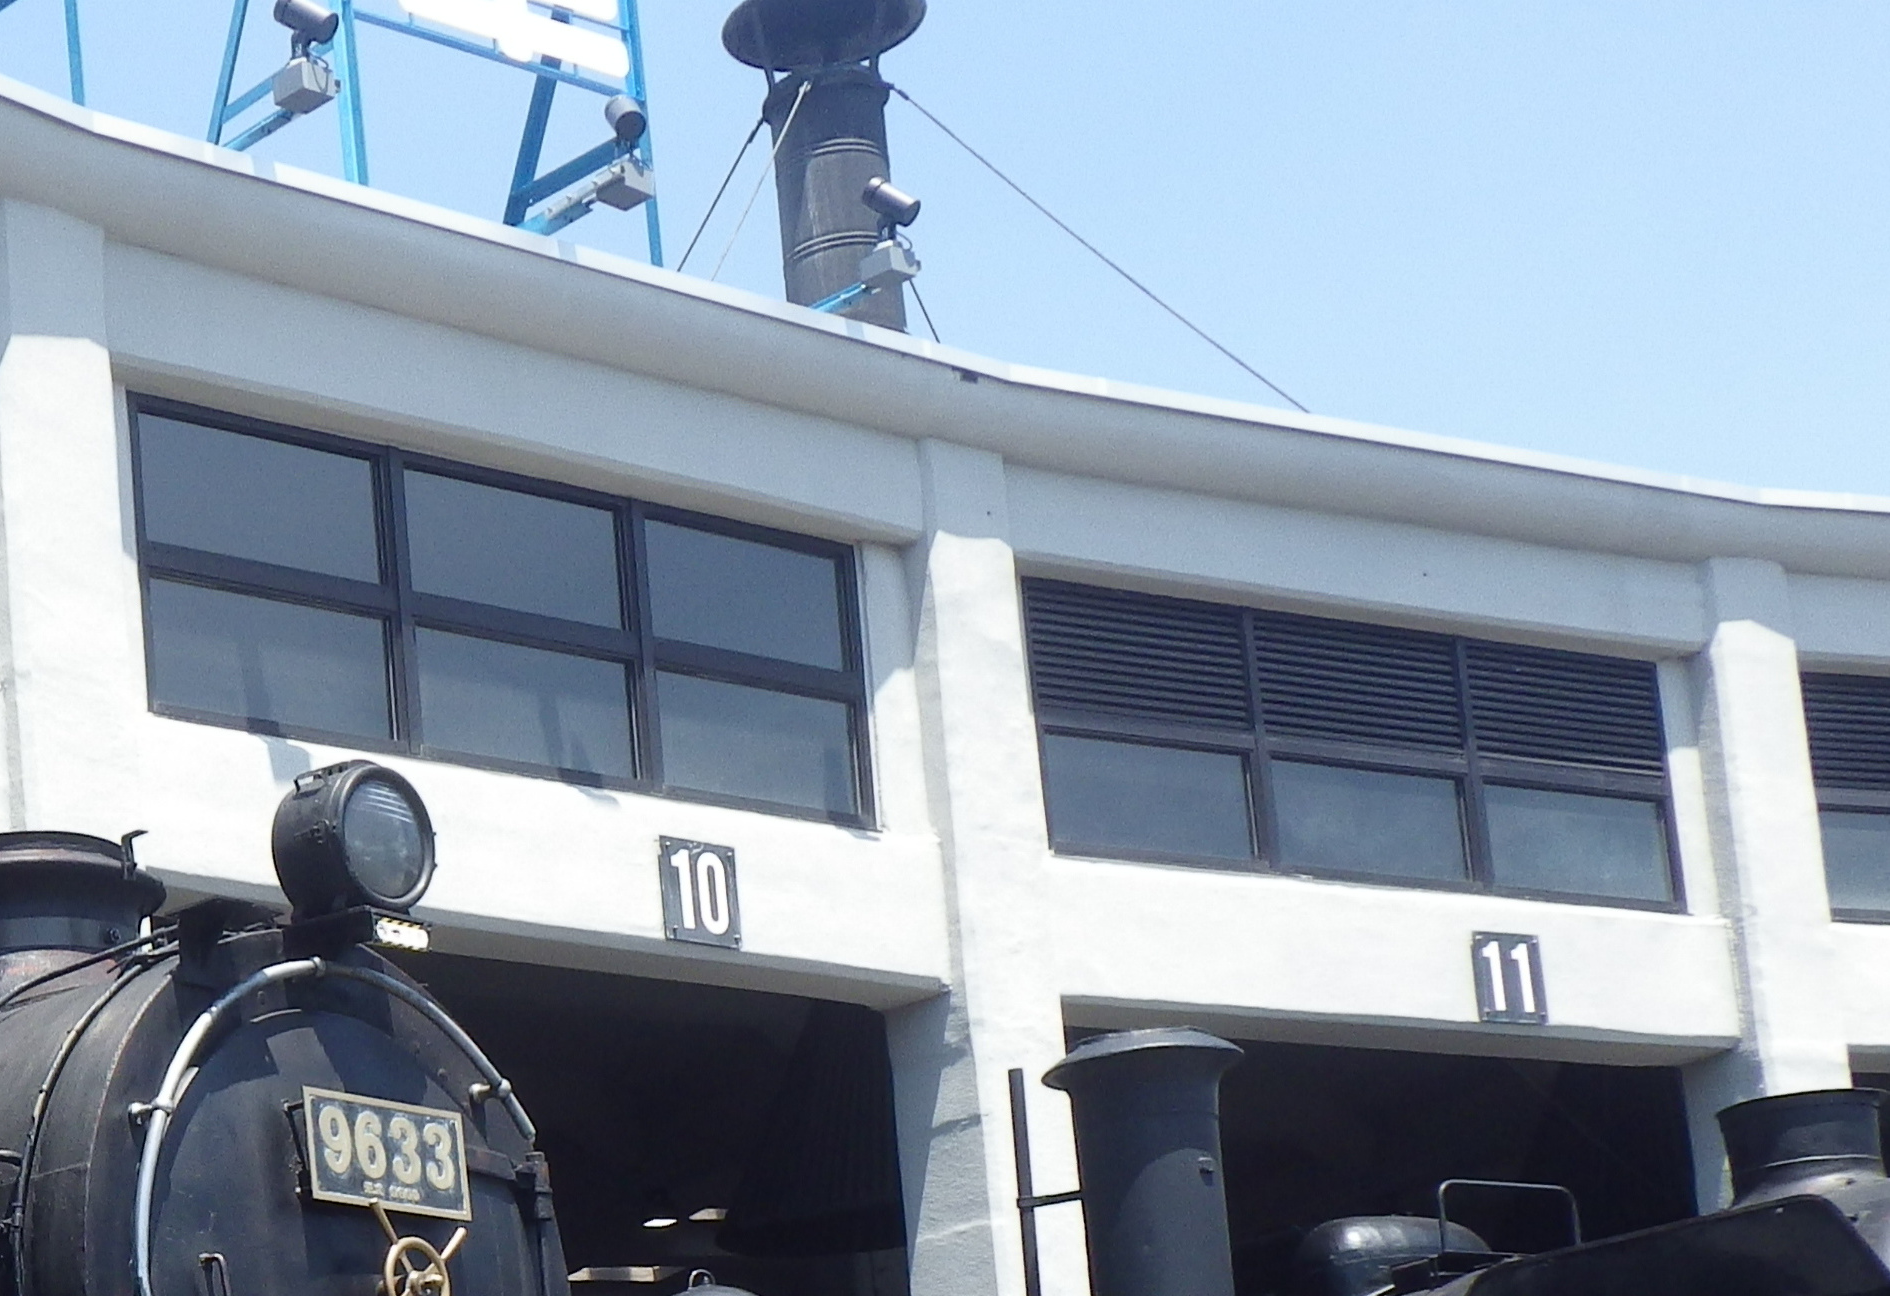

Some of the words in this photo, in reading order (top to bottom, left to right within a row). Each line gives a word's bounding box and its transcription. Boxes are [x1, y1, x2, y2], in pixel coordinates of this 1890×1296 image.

[668, 848, 731, 934] 10
[1481, 940, 1537, 1014] 11
[318, 1105, 455, 1191] 9633
